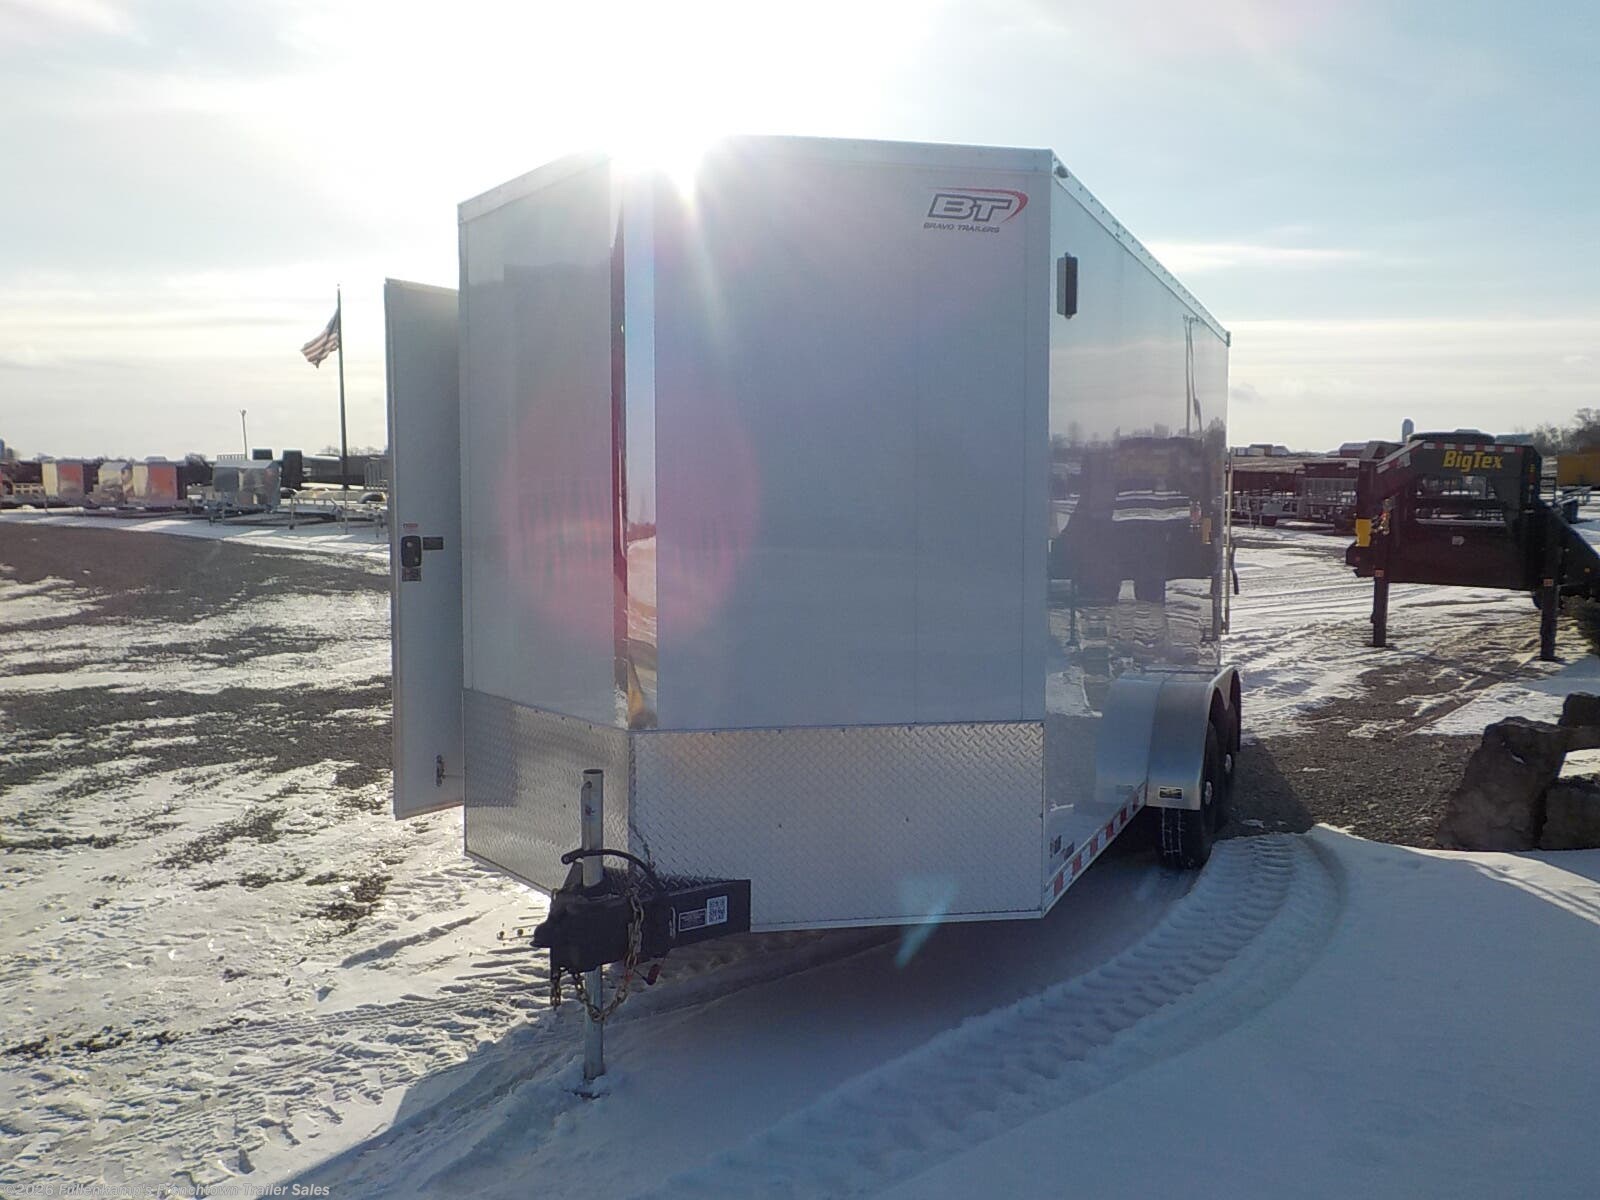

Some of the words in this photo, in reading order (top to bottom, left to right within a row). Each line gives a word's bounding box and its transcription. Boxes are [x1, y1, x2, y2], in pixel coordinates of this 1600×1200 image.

[928, 193, 1013, 222] BT
[923, 222, 955, 231] BRAVO
[957, 224, 1000, 233] TRAILERS
